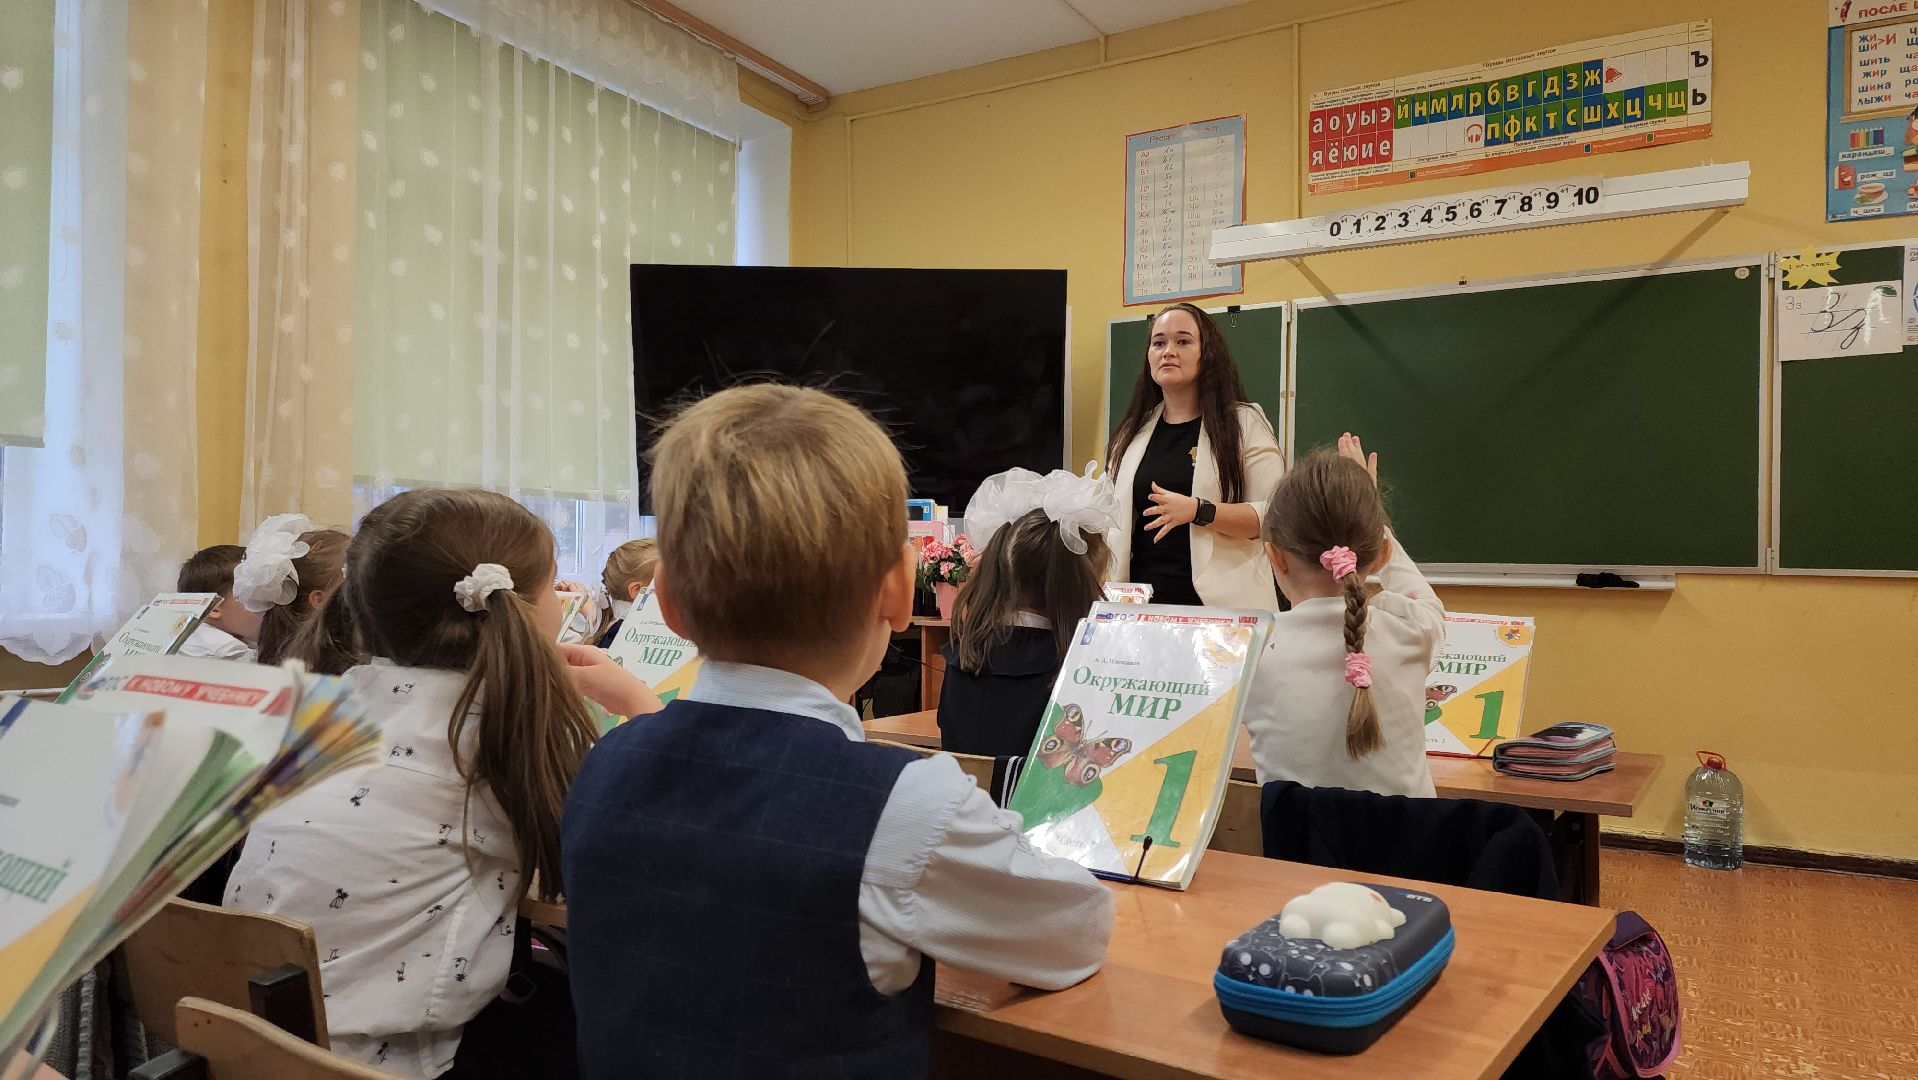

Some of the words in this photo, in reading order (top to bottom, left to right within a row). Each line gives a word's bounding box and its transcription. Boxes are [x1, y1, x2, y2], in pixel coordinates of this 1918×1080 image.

[1858, 2, 1908, 19] ПОСЛЕ
[1859, 56, 1891, 67] шить
[1862, 69, 1887, 79] жир
[1858, 81, 1892, 93] шина
[1857, 94, 1892, 106] лыжи
[1329, 221, 1342, 237] 0
[1352, 218, 1362, 234] 1
[1374, 215, 1387, 232] 2
[1397, 211, 1410, 228] 3
[1420, 208, 1433, 224] 4
[1444, 205, 1457, 222] 5
[1469, 201, 1483, 219] 6
[1494, 198, 1508, 216] 7
[1519, 195, 1533, 212] 8
[1546, 191, 1560, 209] 9
[1573, 186, 1600, 206] 10
[1147, 616, 1184, 624] НОВОМУ
[637, 646, 683, 667] МИР
[1434, 660, 1488, 676] МИР
[1072, 666, 1210, 697] Окружающий
[1107, 692, 1182, 720] МИР
[1468, 690, 1506, 740] 1
[1129, 749, 1198, 848] 1
